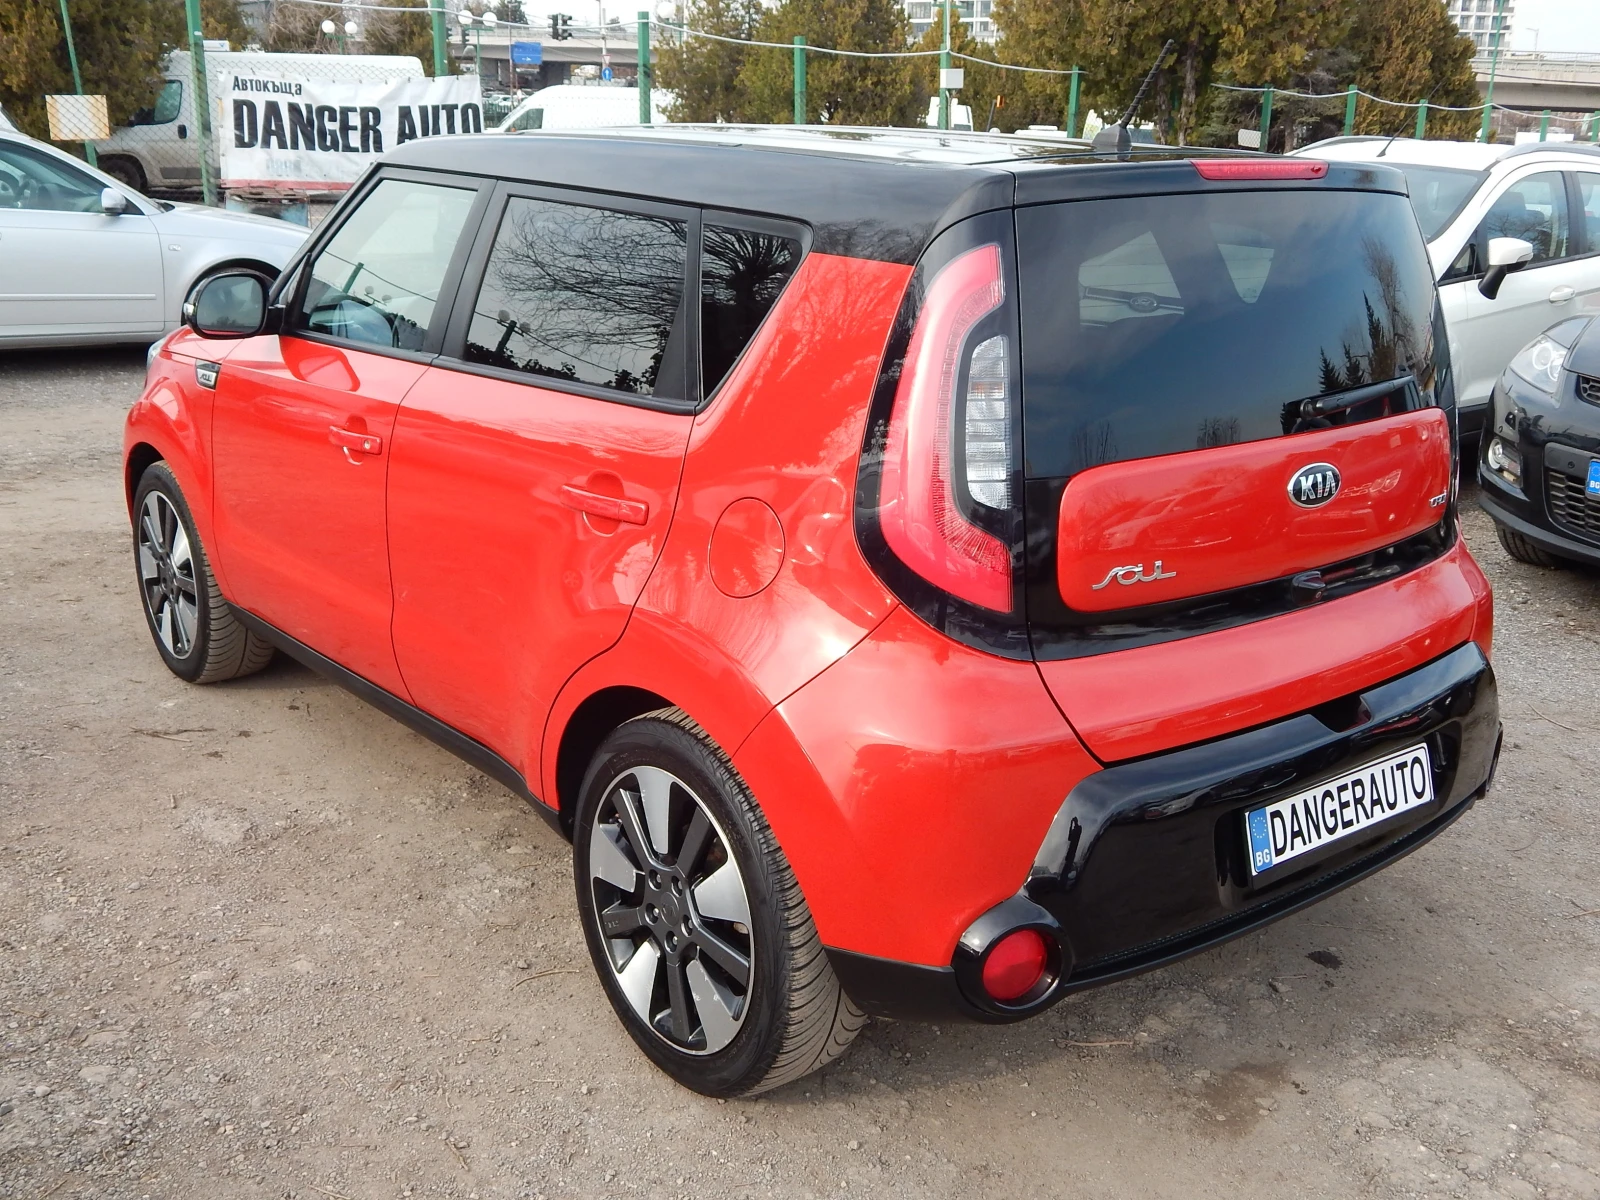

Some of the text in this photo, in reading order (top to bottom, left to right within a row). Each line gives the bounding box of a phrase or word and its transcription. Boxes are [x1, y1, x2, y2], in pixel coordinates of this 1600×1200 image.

[233, 99, 482, 153] DANGER AUTO
[1299, 470, 1336, 501] KIA
[1269, 756, 1426, 858] DANGERAUTO
[1255, 848, 1271, 867] BG
